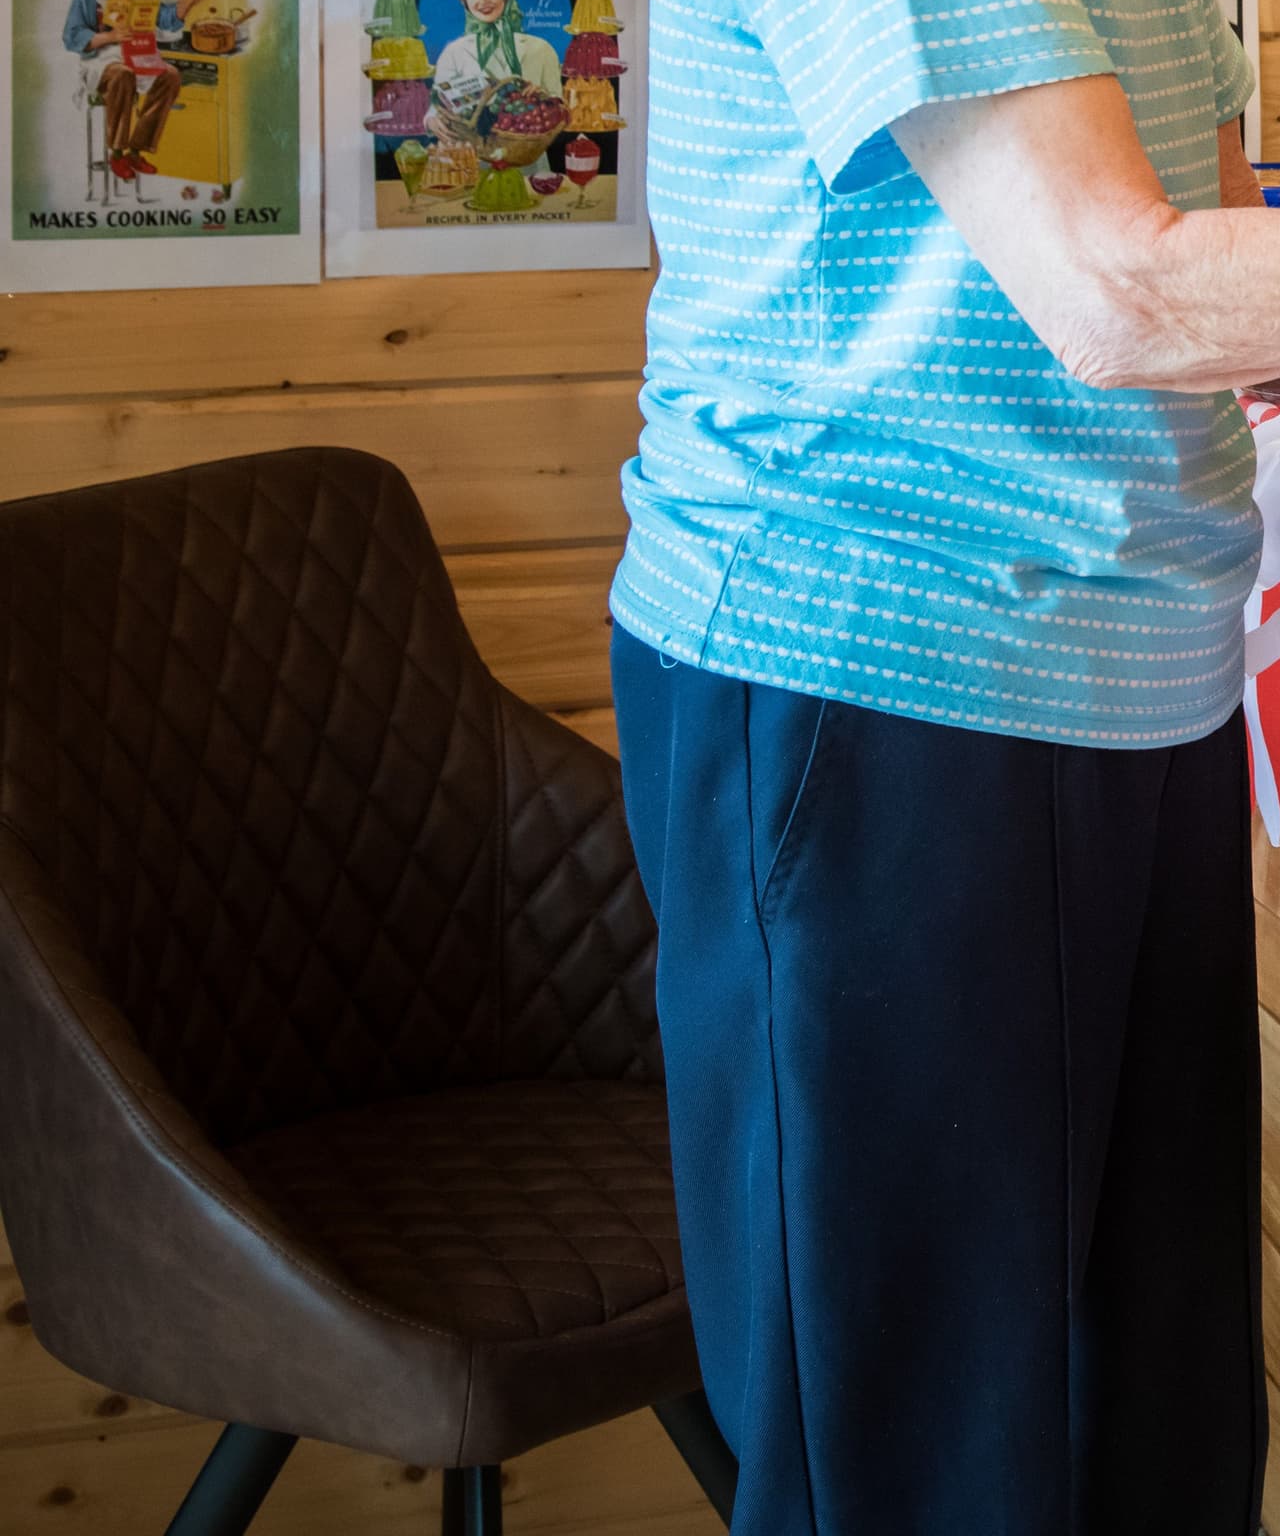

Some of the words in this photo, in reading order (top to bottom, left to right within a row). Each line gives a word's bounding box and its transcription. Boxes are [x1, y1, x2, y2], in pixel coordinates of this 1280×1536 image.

[29, 211, 98, 230] MAKES
[106, 209, 192, 228] COOKING
[202, 207, 226, 226] SO
[233, 206, 282, 226] EASY
[425, 215, 471, 225] RECIPES
[476, 214, 488, 224] IN
[492, 213, 527, 223] EVERY
[531, 211, 572, 222] PACKET
